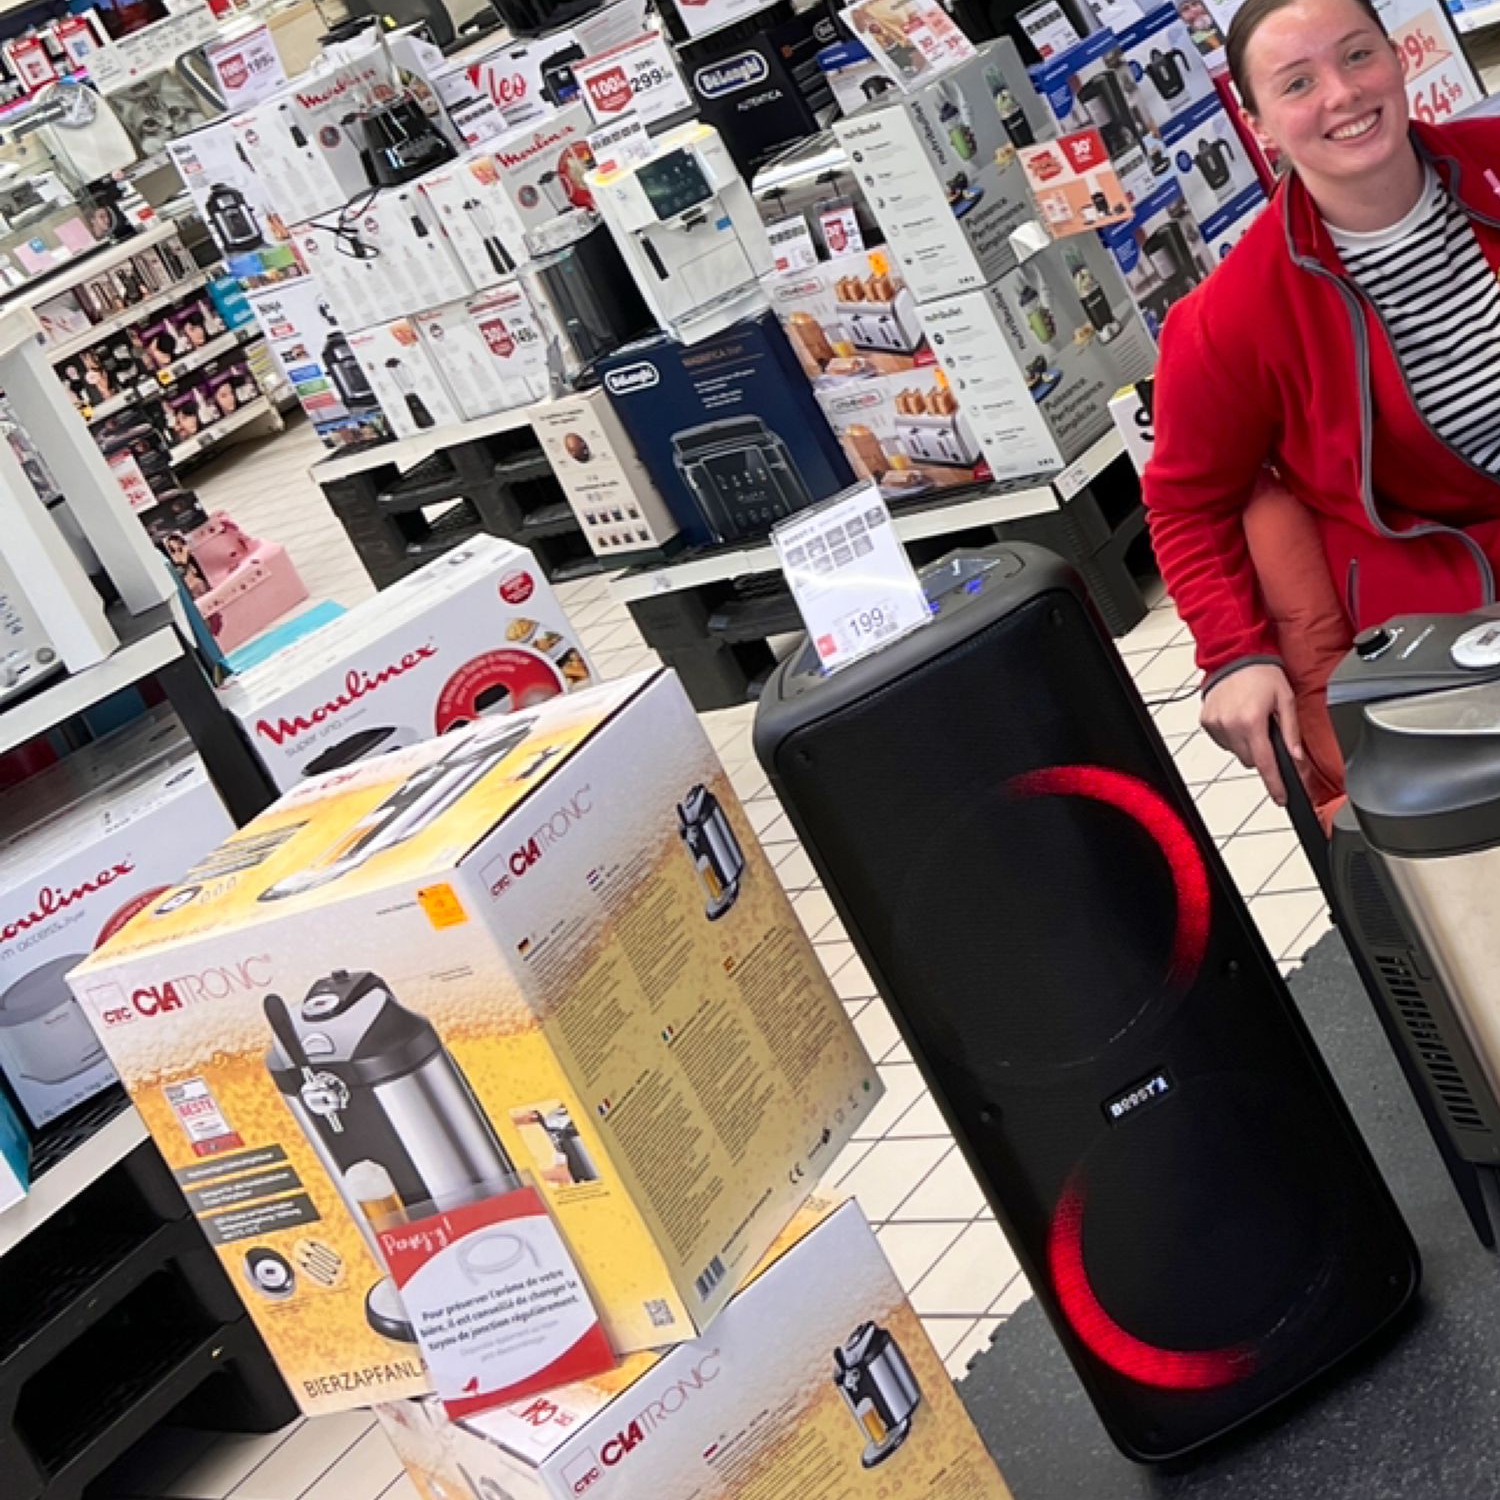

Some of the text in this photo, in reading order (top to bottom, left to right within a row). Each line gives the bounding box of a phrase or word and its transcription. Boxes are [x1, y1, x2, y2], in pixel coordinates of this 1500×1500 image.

[256, 643, 440, 745] Moulinex
[0, 861, 136, 943] oulinex
[422, 1309, 444, 1321] Pour
[446, 1293, 489, 1318] préserver
[526, 1275, 538, 1287] de
[539, 1269, 564, 1282] votre
[449, 1318, 456, 1328] il
[456, 1313, 471, 1326] est
[471, 1300, 514, 1321] conseillé
[515, 1295, 528, 1306] de
[529, 1284, 565, 1304] changer
[458, 1330, 470, 1342] de
[471, 1318, 510, 1338] jonction
